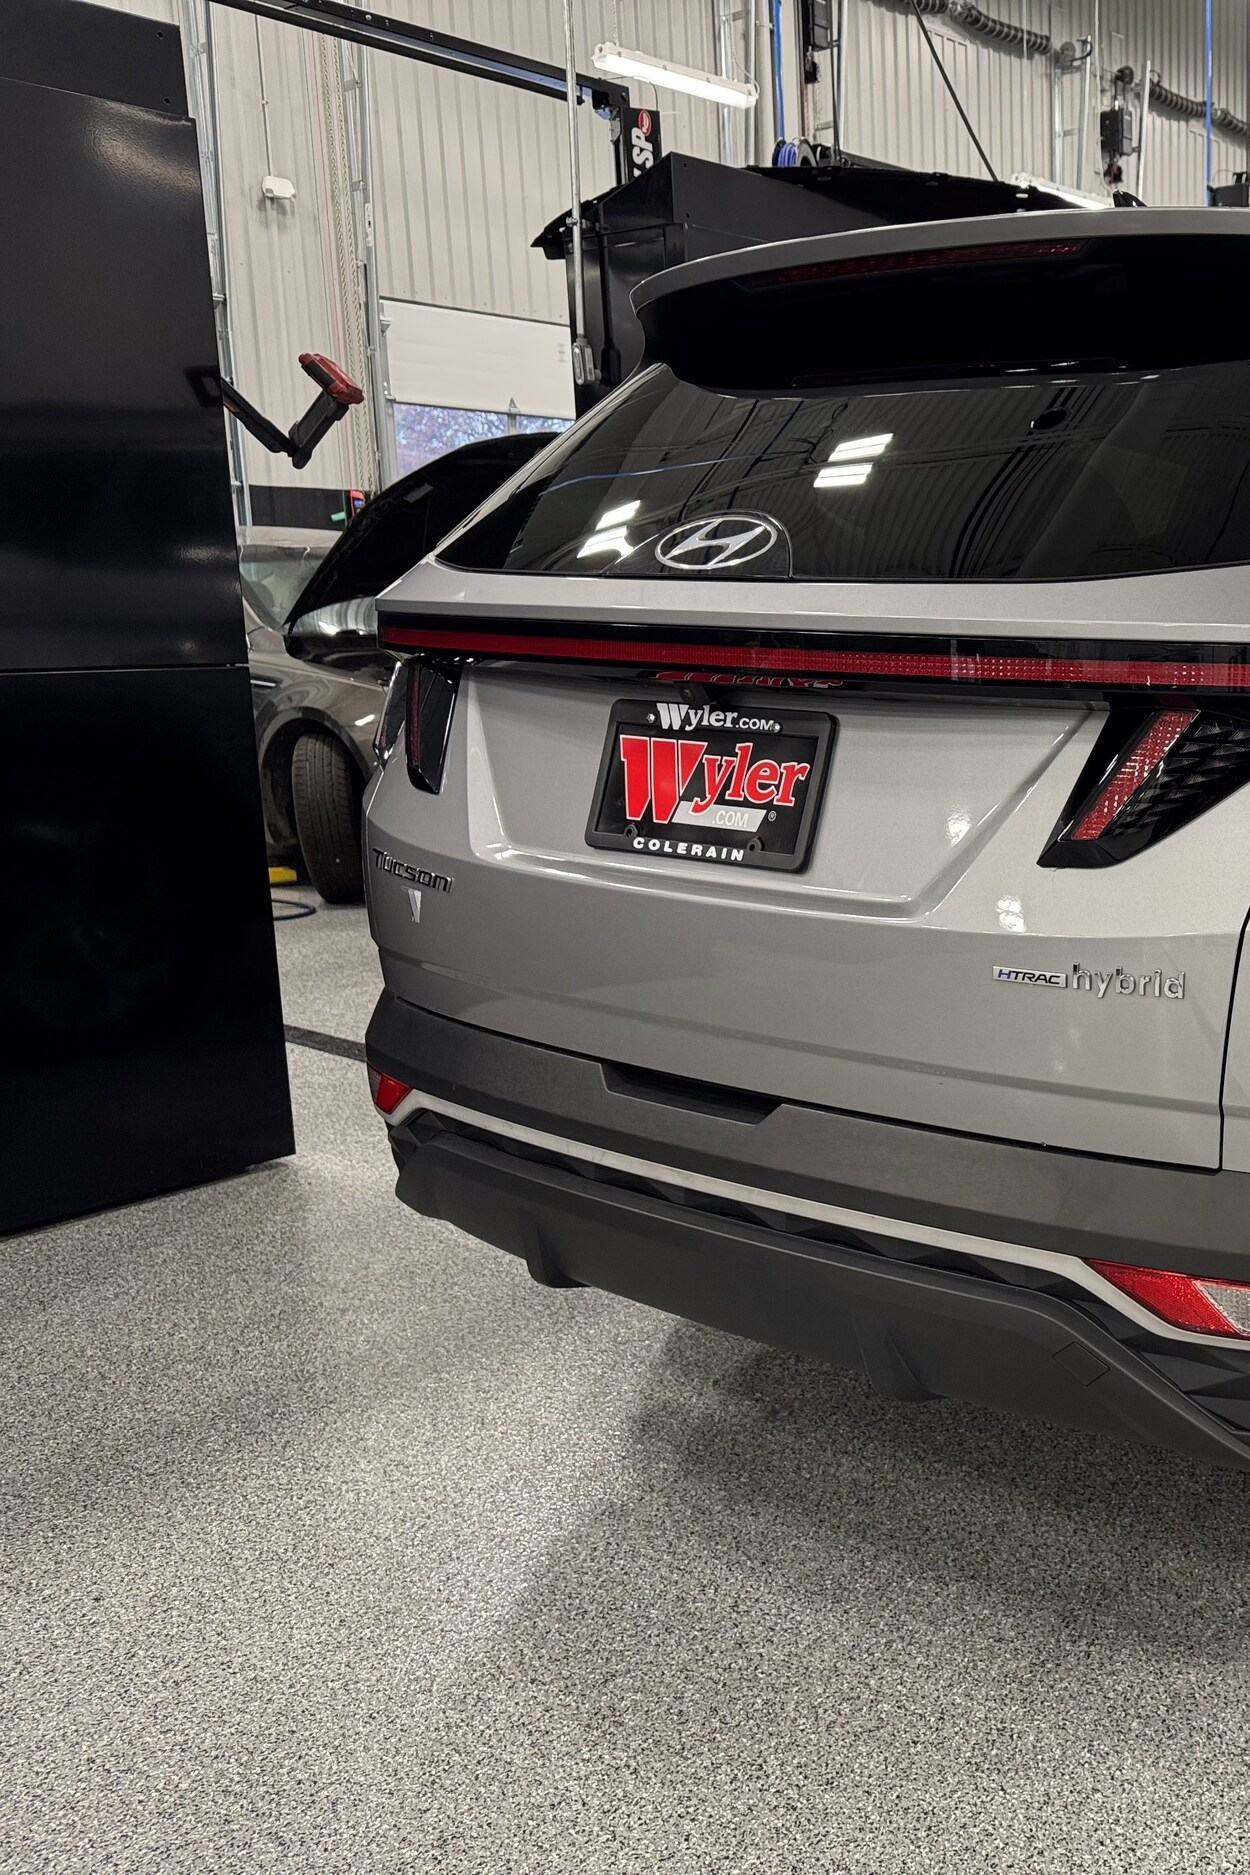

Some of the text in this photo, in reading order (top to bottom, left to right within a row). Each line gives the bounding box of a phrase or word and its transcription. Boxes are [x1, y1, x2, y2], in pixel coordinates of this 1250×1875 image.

[619, 734, 810, 824] Wyler
[632, 837, 744, 862] COLERAIN
[997, 962, 1186, 999] HTRAC hybrid
